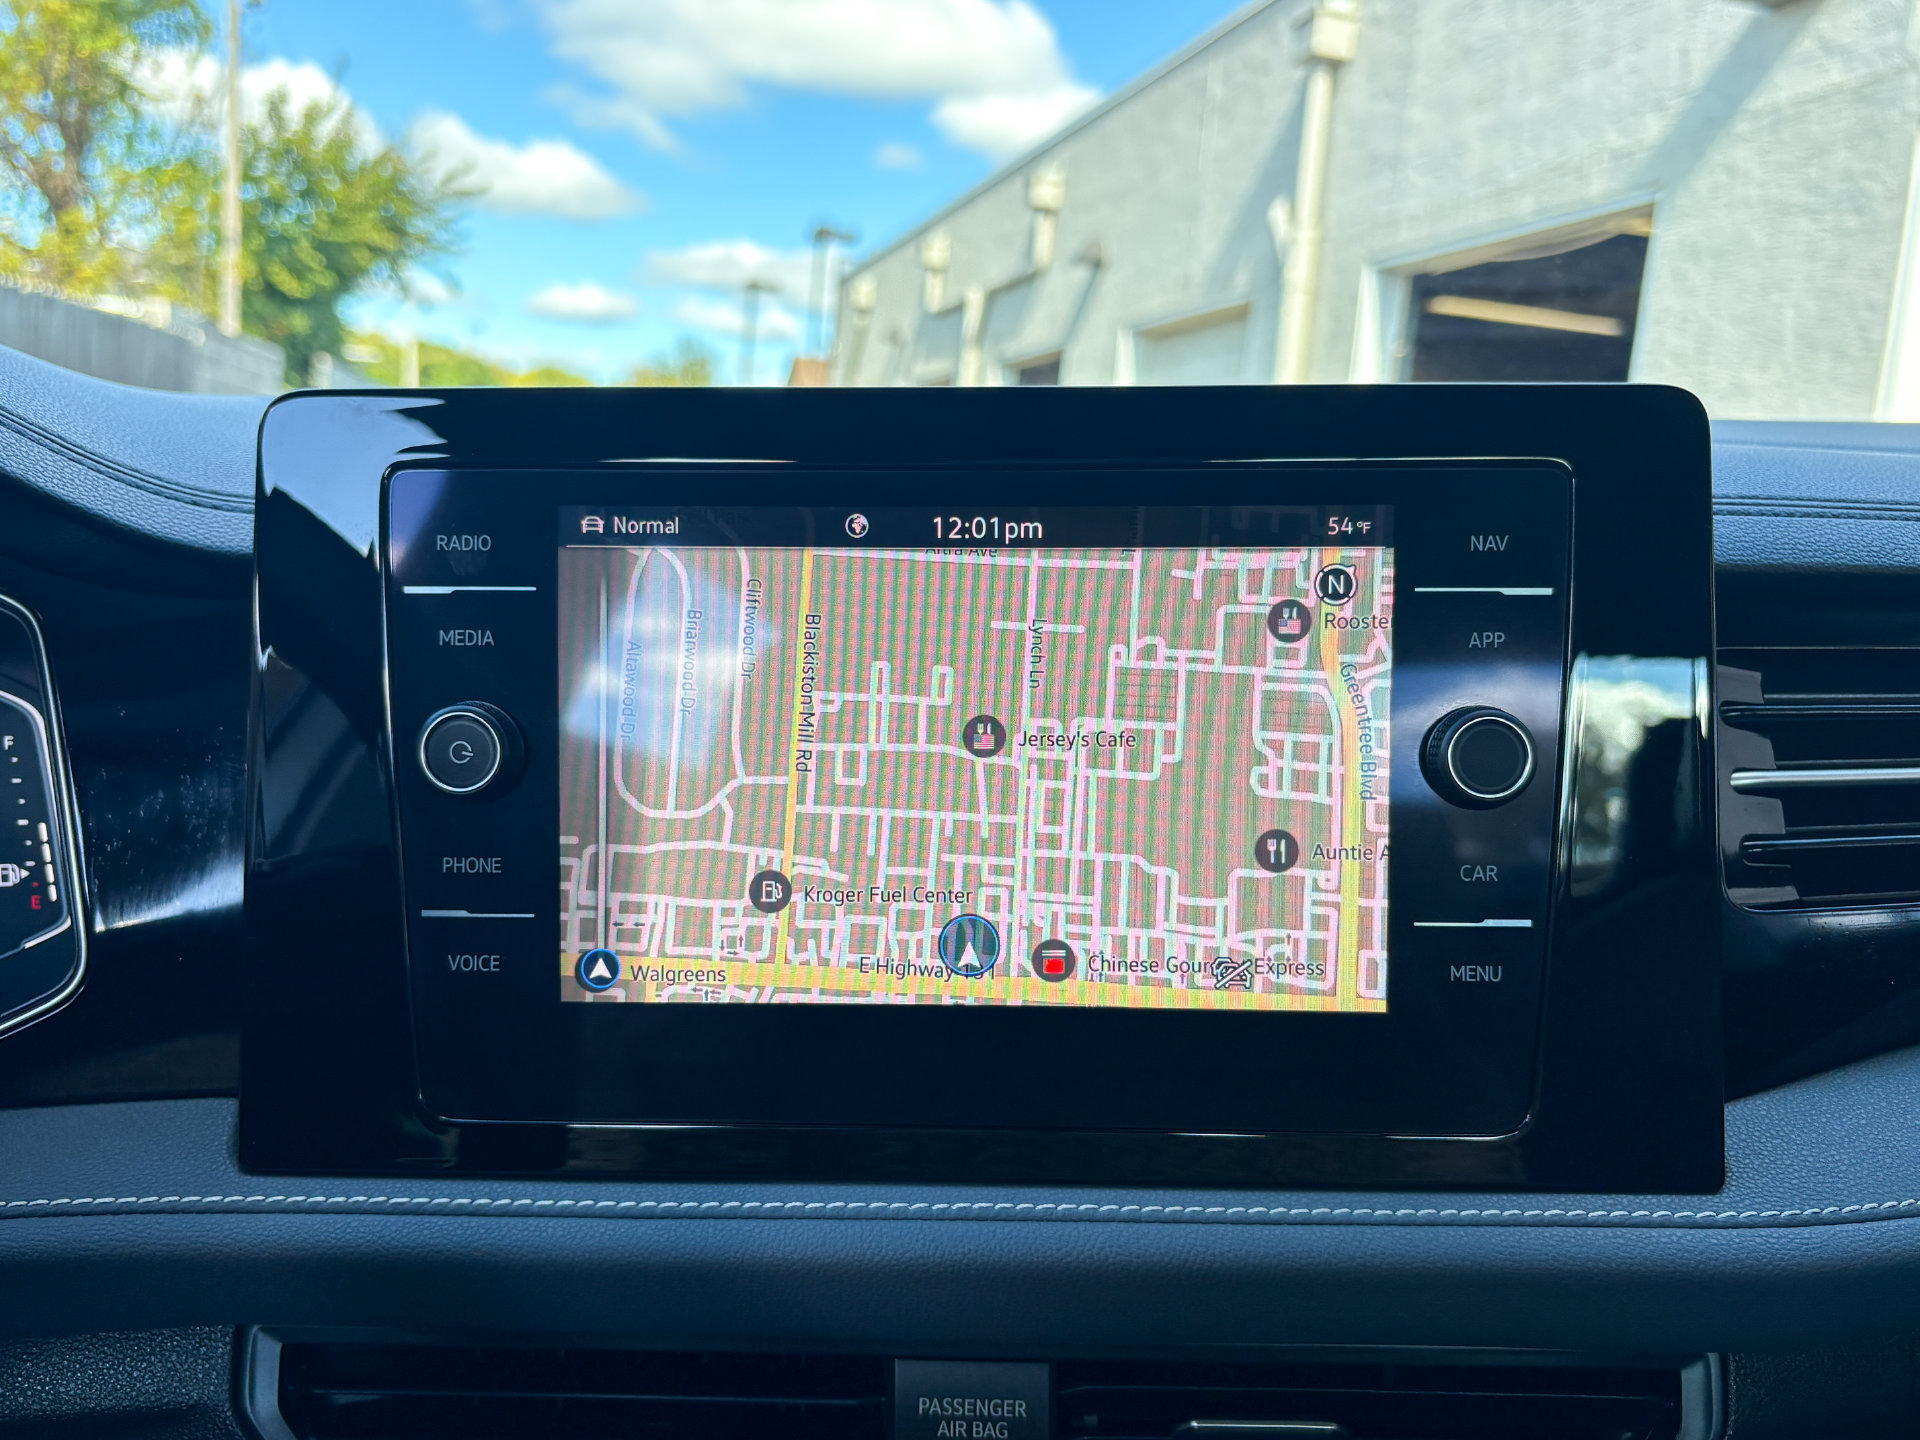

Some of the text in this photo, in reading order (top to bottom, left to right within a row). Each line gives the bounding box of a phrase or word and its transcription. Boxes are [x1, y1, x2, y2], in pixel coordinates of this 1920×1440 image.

[613, 516, 680, 535] Normal
[933, 516, 1043, 545] 12:01pm
[436, 534, 492, 551] RADIO
[1470, 535, 1509, 551] NAV
[1328, 574, 1345, 595] N
[439, 630, 495, 646] MEDIA
[741, 578, 762, 680] Cliftwood Dr
[1468, 632, 1505, 649] APP
[680, 609, 702, 715] Briarwood Dr
[1028, 619, 1047, 689] Lynch Ln
[620, 640, 642, 741] Altawood Dr
[795, 614, 821, 773] Blackiston Mill Rd
[1018, 730, 1136, 751] Jersey's Cafe
[1340, 664, 1378, 801] Greentree Blvd
[3, 735, 14, 751] F
[1312, 843, 1373, 861] Auntie
[442, 857, 502, 873] PHONE
[1460, 865, 1499, 882] CAR
[31, 895, 42, 910] E
[804, 885, 974, 907] Kroger Fuel Center
[448, 955, 501, 971] VOICE
[859, 956, 871, 974] E
[876, 957, 953, 982] Highway
[1088, 954, 1325, 980] Chinese Gour Express
[630, 964, 726, 986] Walgreens
[1450, 965, 1502, 982] MENU
[918, 1397, 1027, 1417] PASSENGER
[937, 1420, 1009, 1439] AIR BAG
